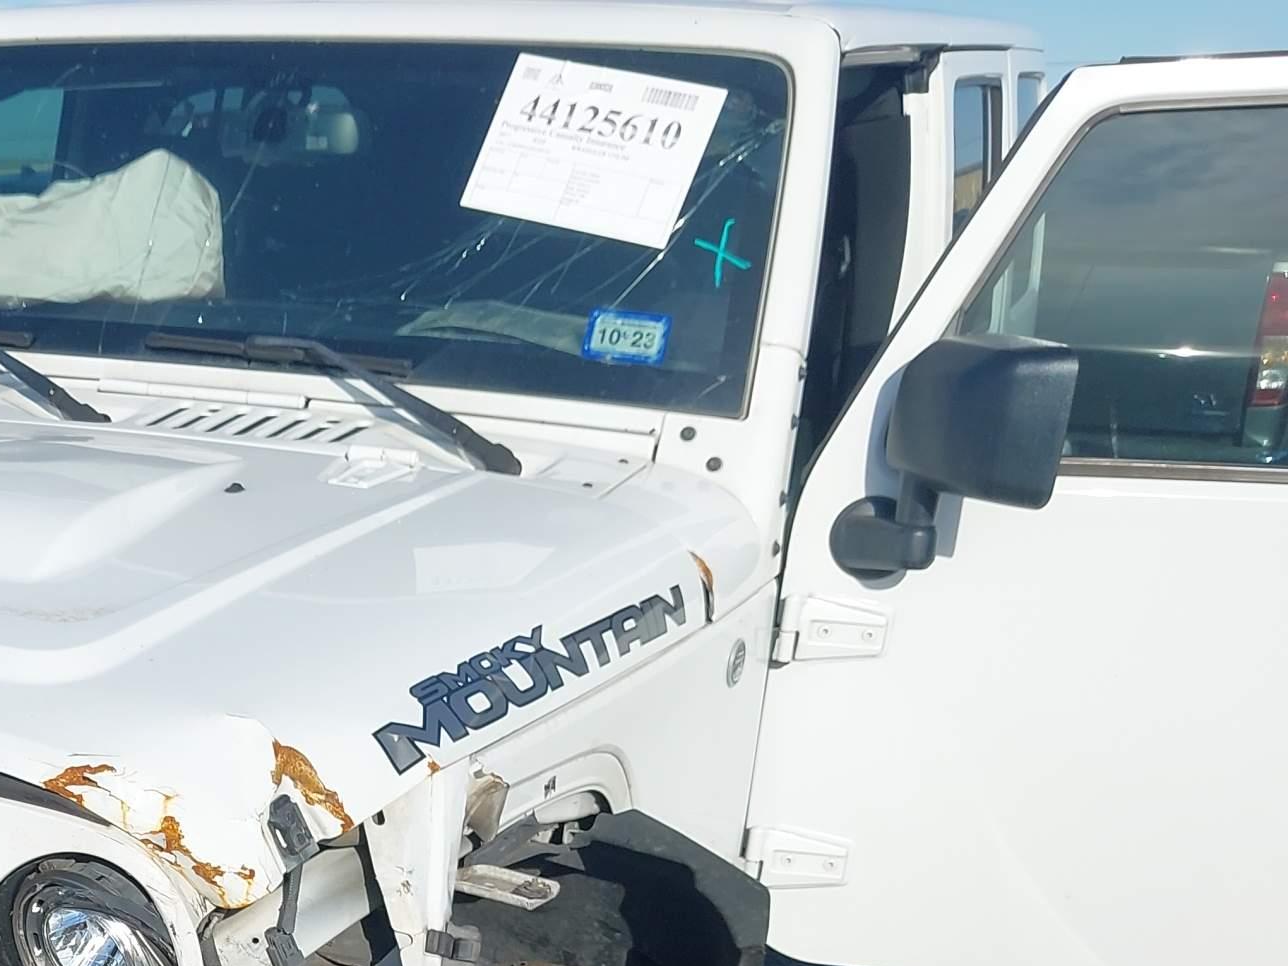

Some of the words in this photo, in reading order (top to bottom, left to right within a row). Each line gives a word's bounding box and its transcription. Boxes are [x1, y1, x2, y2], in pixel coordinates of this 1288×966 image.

[519, 94, 683, 150] 44125610
[598, 327, 621, 346] 10
[372, 584, 687, 776] MOUNTAIN
[409, 624, 543, 704] SMOKY
